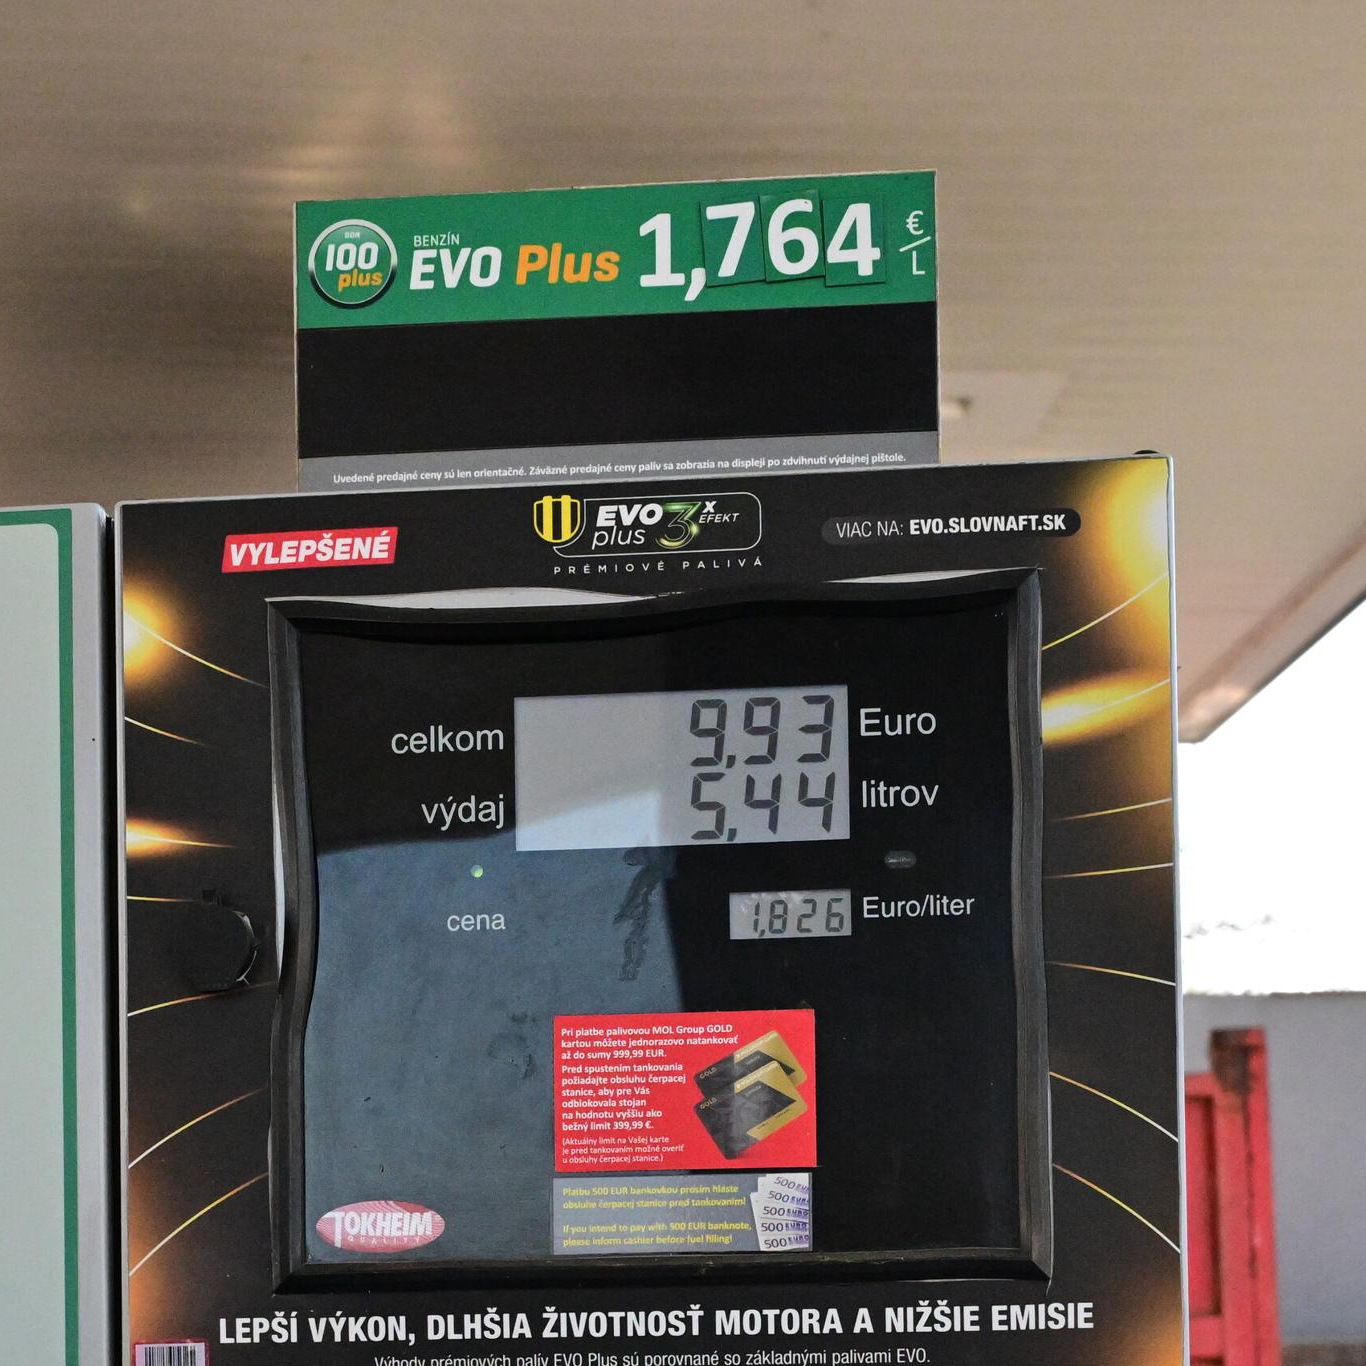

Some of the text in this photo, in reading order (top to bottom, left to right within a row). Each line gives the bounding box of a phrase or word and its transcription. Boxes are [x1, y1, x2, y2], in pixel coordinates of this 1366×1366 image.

[409, 198, 881, 301] EVO Plus 1,764
[413, 232, 460, 247] BENZÍN
[325, 242, 379, 271] 100
[338, 269, 383, 292] plus
[333, 472, 374, 483] Uvedené
[376, 470, 417, 483] predajné
[420, 471, 442, 480] ceny
[444, 468, 454, 478] sú
[456, 469, 471, 478] len
[473, 466, 527, 478] orientačné.
[529, 464, 567, 475] Záväzné
[569, 463, 611, 475] predajné
[613, 464, 636, 473] ceny
[638, 461, 661, 472] palív
[663, 462, 673, 470] sa
[675, 459, 715, 469] zobrazia
[731, 457, 765, 468] displeji
[767, 459, 780, 467] po
[782, 455, 827, 466] zdvihnutí
[829, 454, 869, 465] výdajnej
[871, 453, 906, 464] pištole.
[595, 503, 664, 526] EVO
[699, 510, 740, 525] EFEKT
[836, 514, 1065, 537] VIAC NA: EVO.SLOVNAFT.SK
[230, 530, 390, 566] VYLEPŠENÉ
[592, 525, 647, 549] plus
[553, 556, 763, 575] PRÉMIOVÉ PALIVÁ
[391, 694, 937, 769] celkom 9,93 Euro
[421, 770, 939, 842] výdaj 5,44 litrov
[446, 892, 975, 937] cena 1,826 Euro/liter
[561, 1024, 732, 1037] Pri platbe palivovou MOL Group GOLD
[561, 1034, 738, 1047] kartou môžete jednorazovo natankovať
[561, 1048, 666, 1059] až do sumy 999,99 EUR.
[327, 1210, 434, 1248] TOKHEIM
[219, 1299, 1093, 1345] LEPŠÍ VÝKON, DLHŠIA ŽIVOTNOSŤ MOTORA A NIŽŠIE EMISIE
[553, 1352, 582, 1366] EVO
[588, 1352, 617, 1366] Plus
[622, 1351, 638, 1366] sú
[724, 1353, 740, 1365] so
[745, 1348, 826, 1366] základnými
[832, 1348, 891, 1366] palivami
[896, 1347, 929, 1362] EVO.
